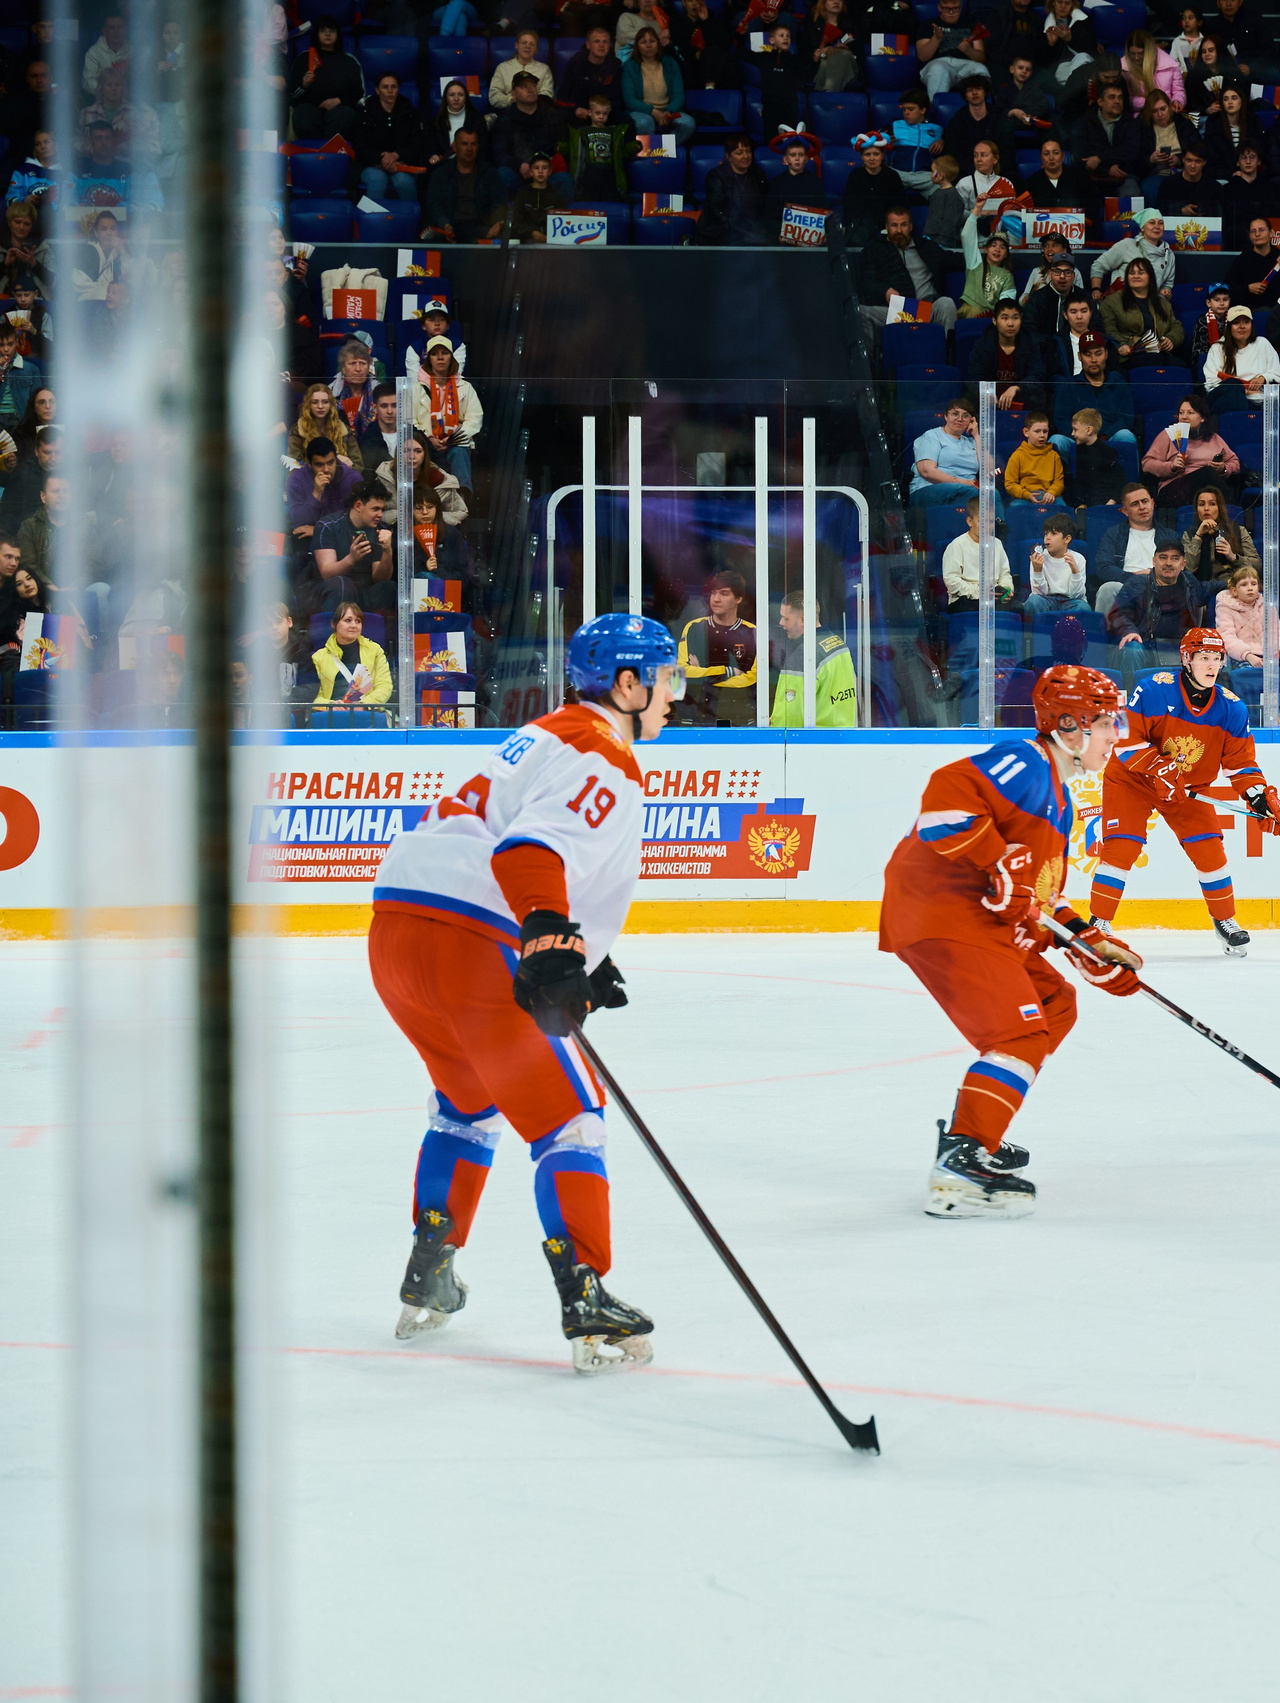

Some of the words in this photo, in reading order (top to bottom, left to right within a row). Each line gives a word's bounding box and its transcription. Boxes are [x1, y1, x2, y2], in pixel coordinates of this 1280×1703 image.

[783, 208, 824, 229] ВПЕРЁ
[783, 224, 826, 245] РОССИ
[1032, 220, 1085, 241] ШАЙБУ
[1085, 334, 1094, 342] H
[988, 753, 1027, 785] 11
[266, 772, 404, 800] КРАСНАЯ
[644, 770, 721, 797] СНАЯ
[566, 774, 616, 829] 19
[259, 808, 404, 842] МАШИНА
[666, 844, 727, 858] ПРОГРАММА
[328, 864, 380, 878] ХОККЕИСТ
[646, 862, 712, 875] ХОККЕИСТОВ
[522, 934, 588, 960] BAUE
[1191, 1017, 1245, 1060] CCM
